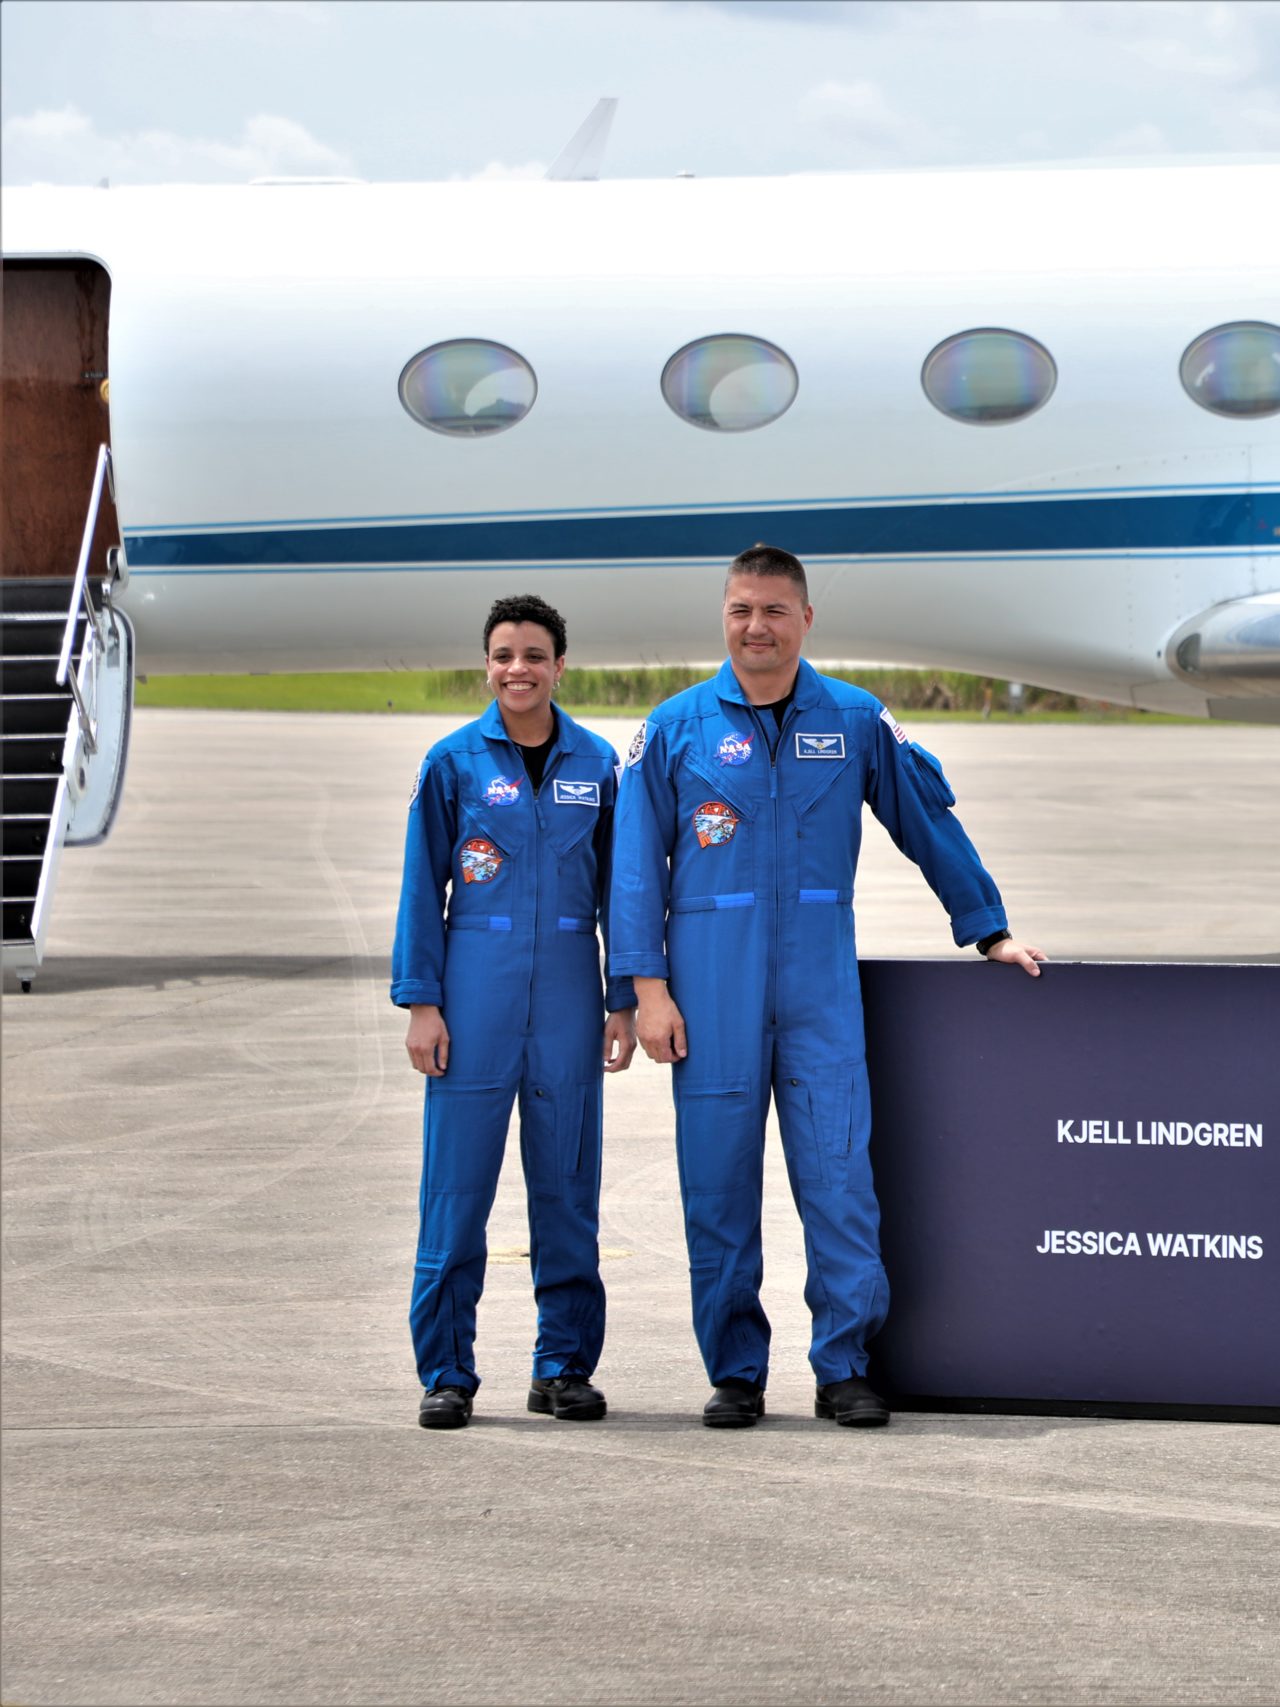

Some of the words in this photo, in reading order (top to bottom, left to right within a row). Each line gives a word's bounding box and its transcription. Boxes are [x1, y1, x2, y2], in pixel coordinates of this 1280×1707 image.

[1057, 1119, 1132, 1145] KJELL
[1136, 1120, 1263, 1148] LINDGREN
[1036, 1229, 1143, 1256] JESSICA
[1146, 1232, 1264, 1260] WATKINS
